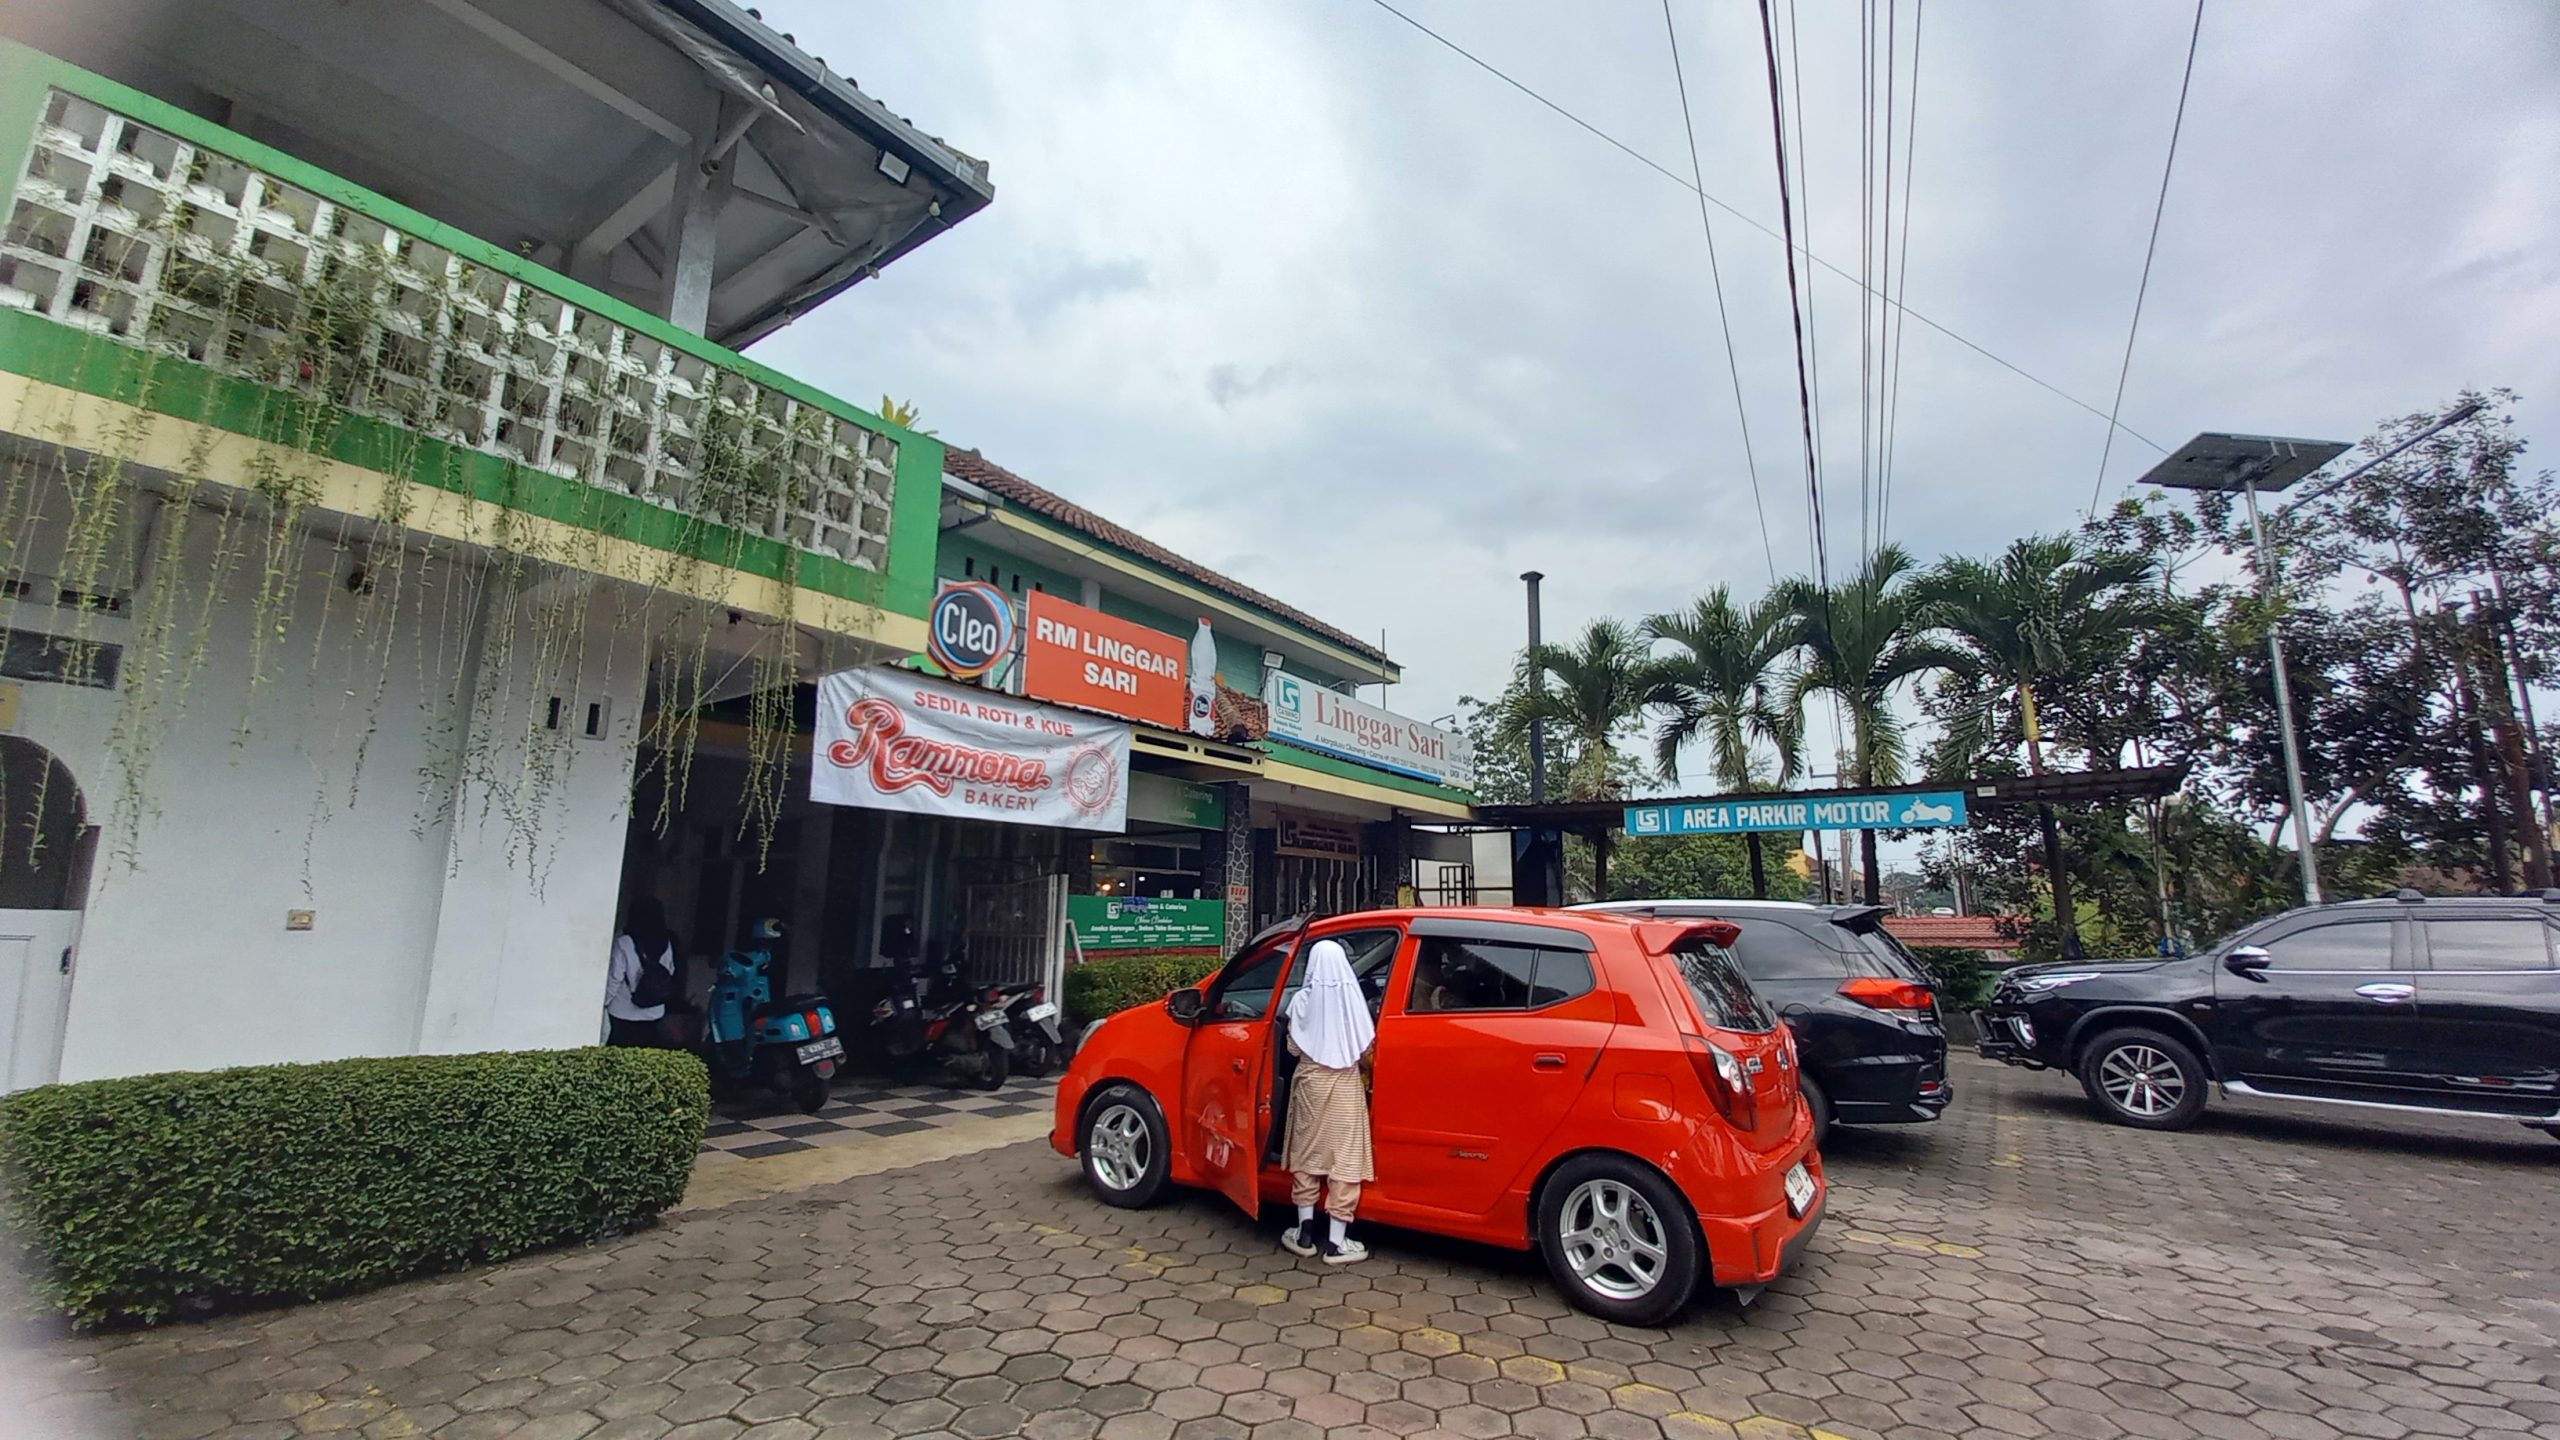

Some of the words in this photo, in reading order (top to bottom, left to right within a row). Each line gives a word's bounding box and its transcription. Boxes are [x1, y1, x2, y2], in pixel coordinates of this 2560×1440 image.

[942, 602, 998, 656] Cleo
[1036, 616, 1078, 650] RM
[1082, 631, 1179, 681] LINGGAR
[1083, 661, 1138, 696] SARI
[914, 690, 970, 718] SEDIA
[977, 704, 1019, 727] ROTI
[1024, 714, 1037, 730] &
[1040, 719, 1074, 738] KUE
[1315, 690, 1403, 750] Linggar
[1408, 722, 1445, 761] Sari
[828, 698, 1053, 798] Rammona
[964, 788, 1038, 812] BAKERY
[1682, 806, 1731, 830] AREA
[1736, 803, 1808, 828] PARKIR
[1814, 801, 1891, 826] MOTOR
